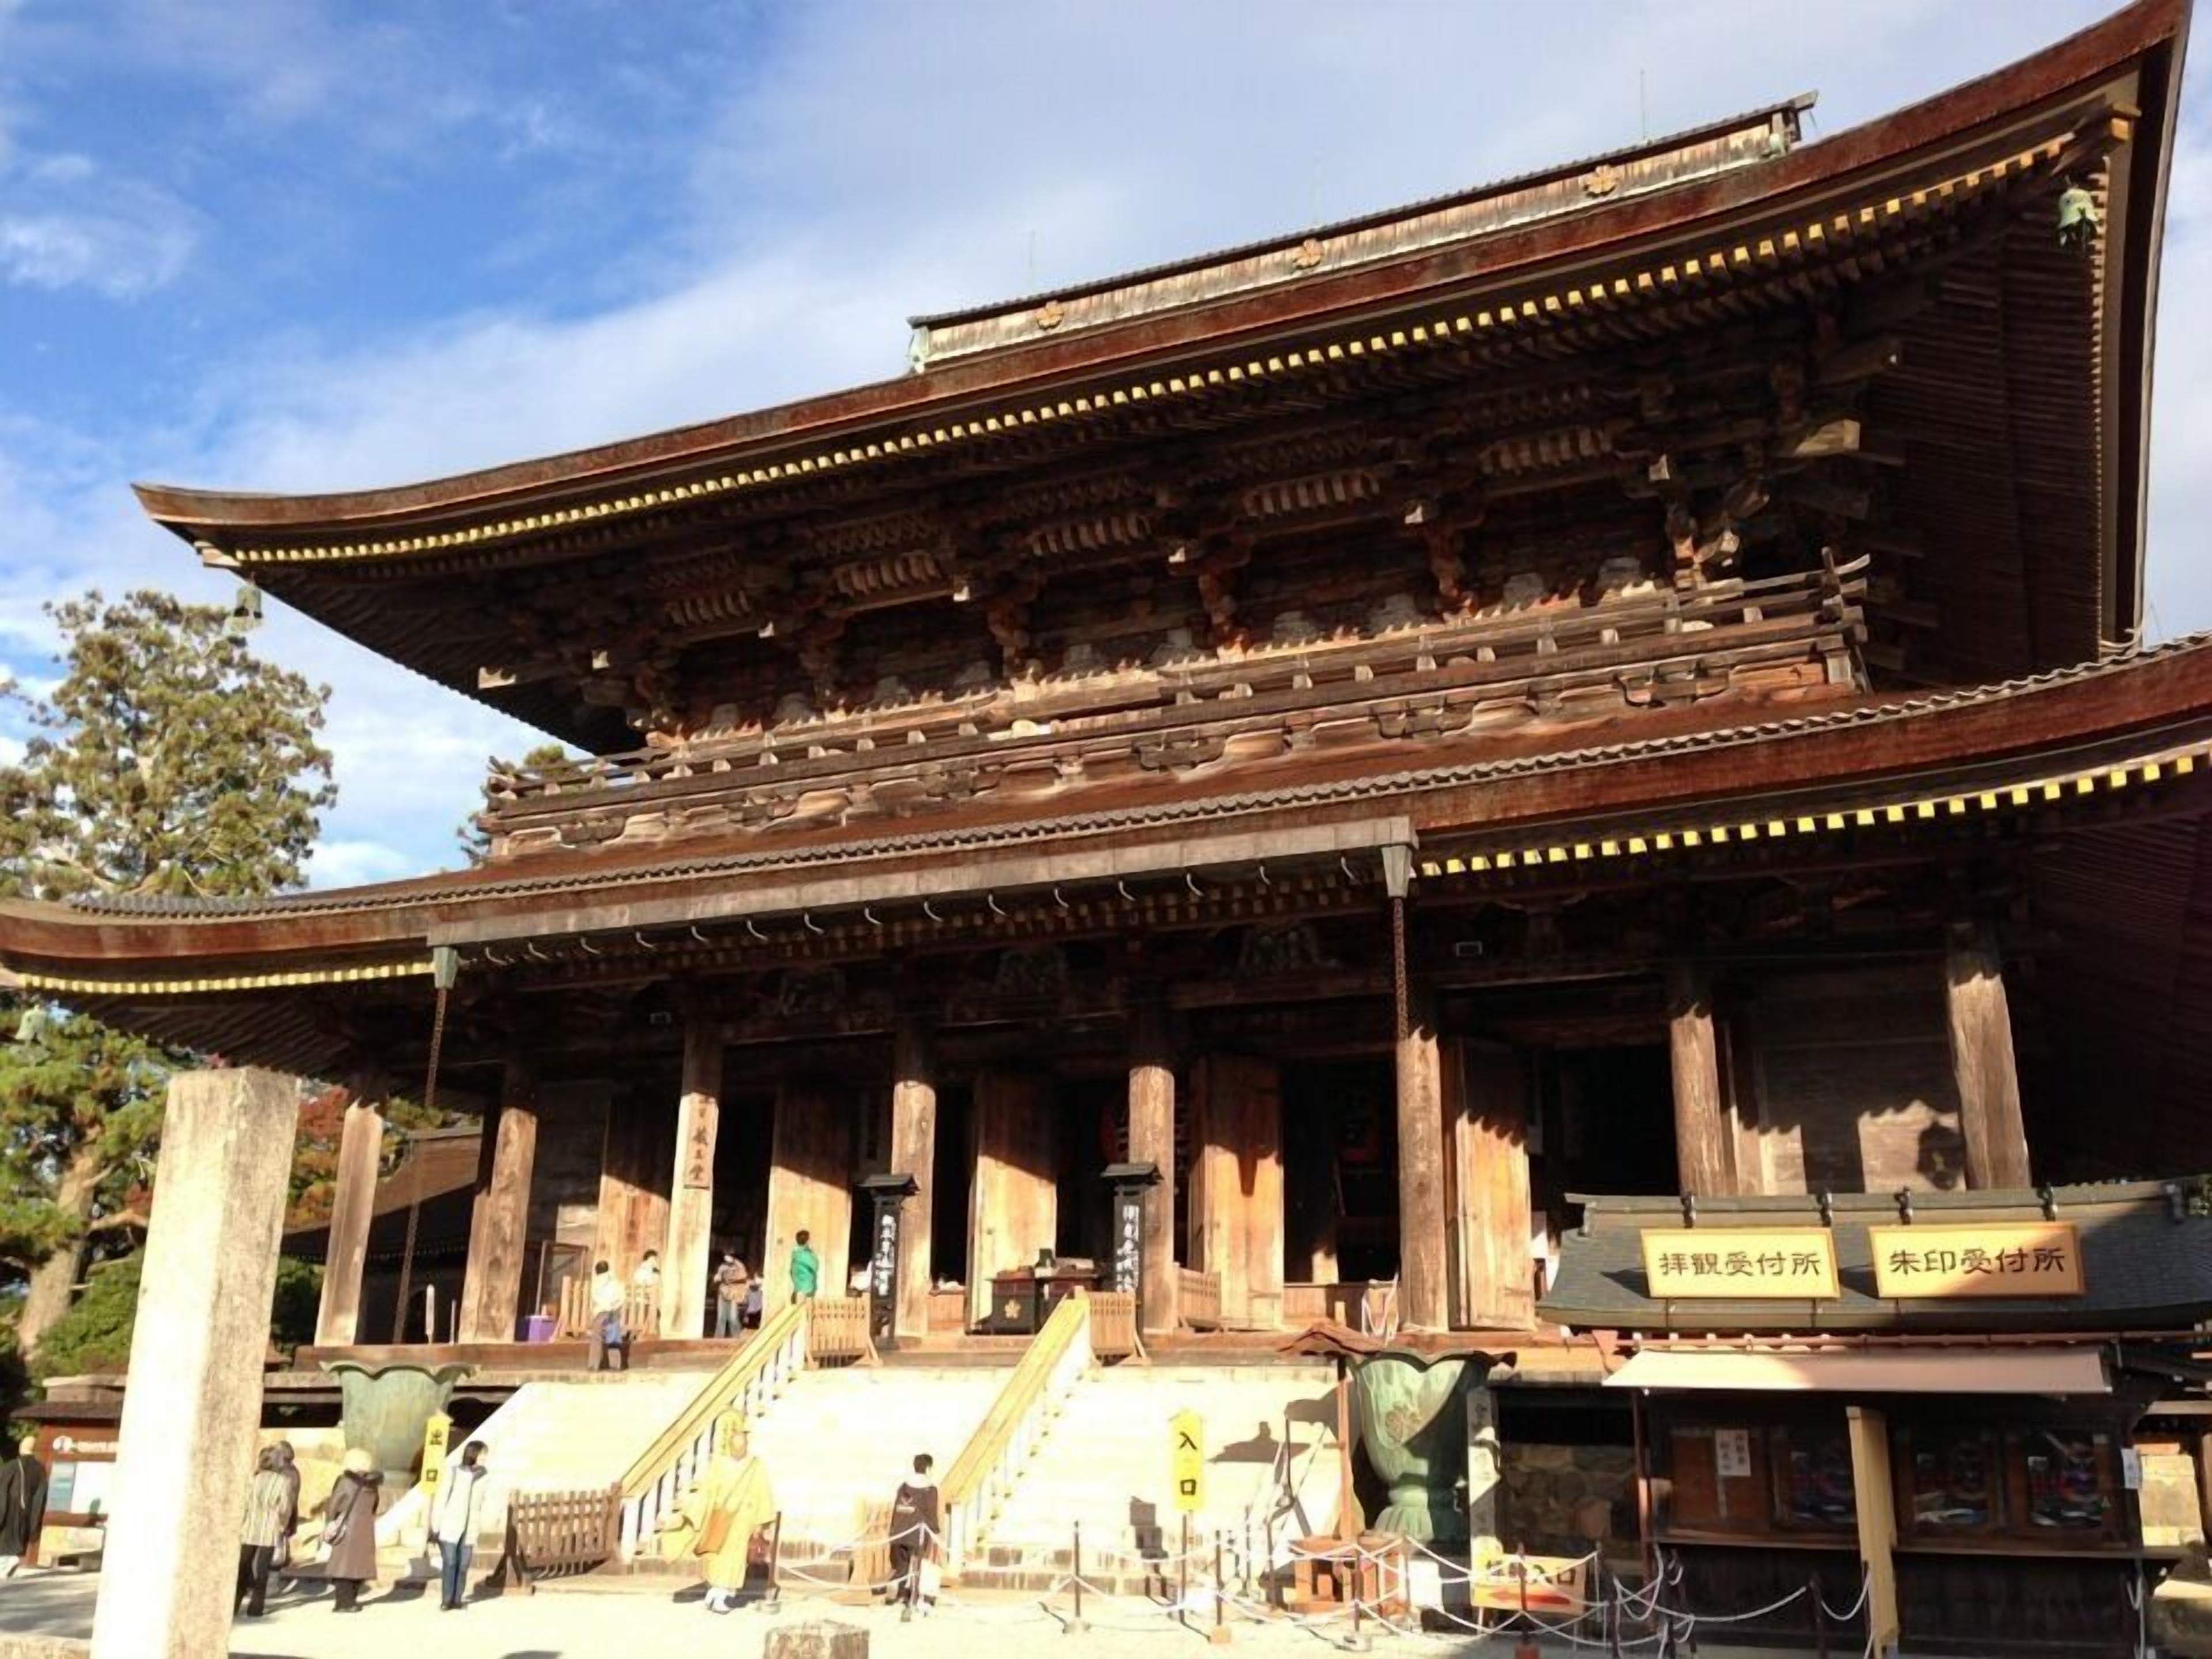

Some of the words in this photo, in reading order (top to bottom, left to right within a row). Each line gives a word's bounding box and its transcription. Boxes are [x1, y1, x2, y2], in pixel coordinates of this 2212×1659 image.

[1658, 1251, 1820, 1277] 拝観受付所
[1889, 1246, 2065, 1275] 朱印受付所
[426, 1429, 442, 1482] 出口
[1179, 1431, 1197, 1496] 入口
